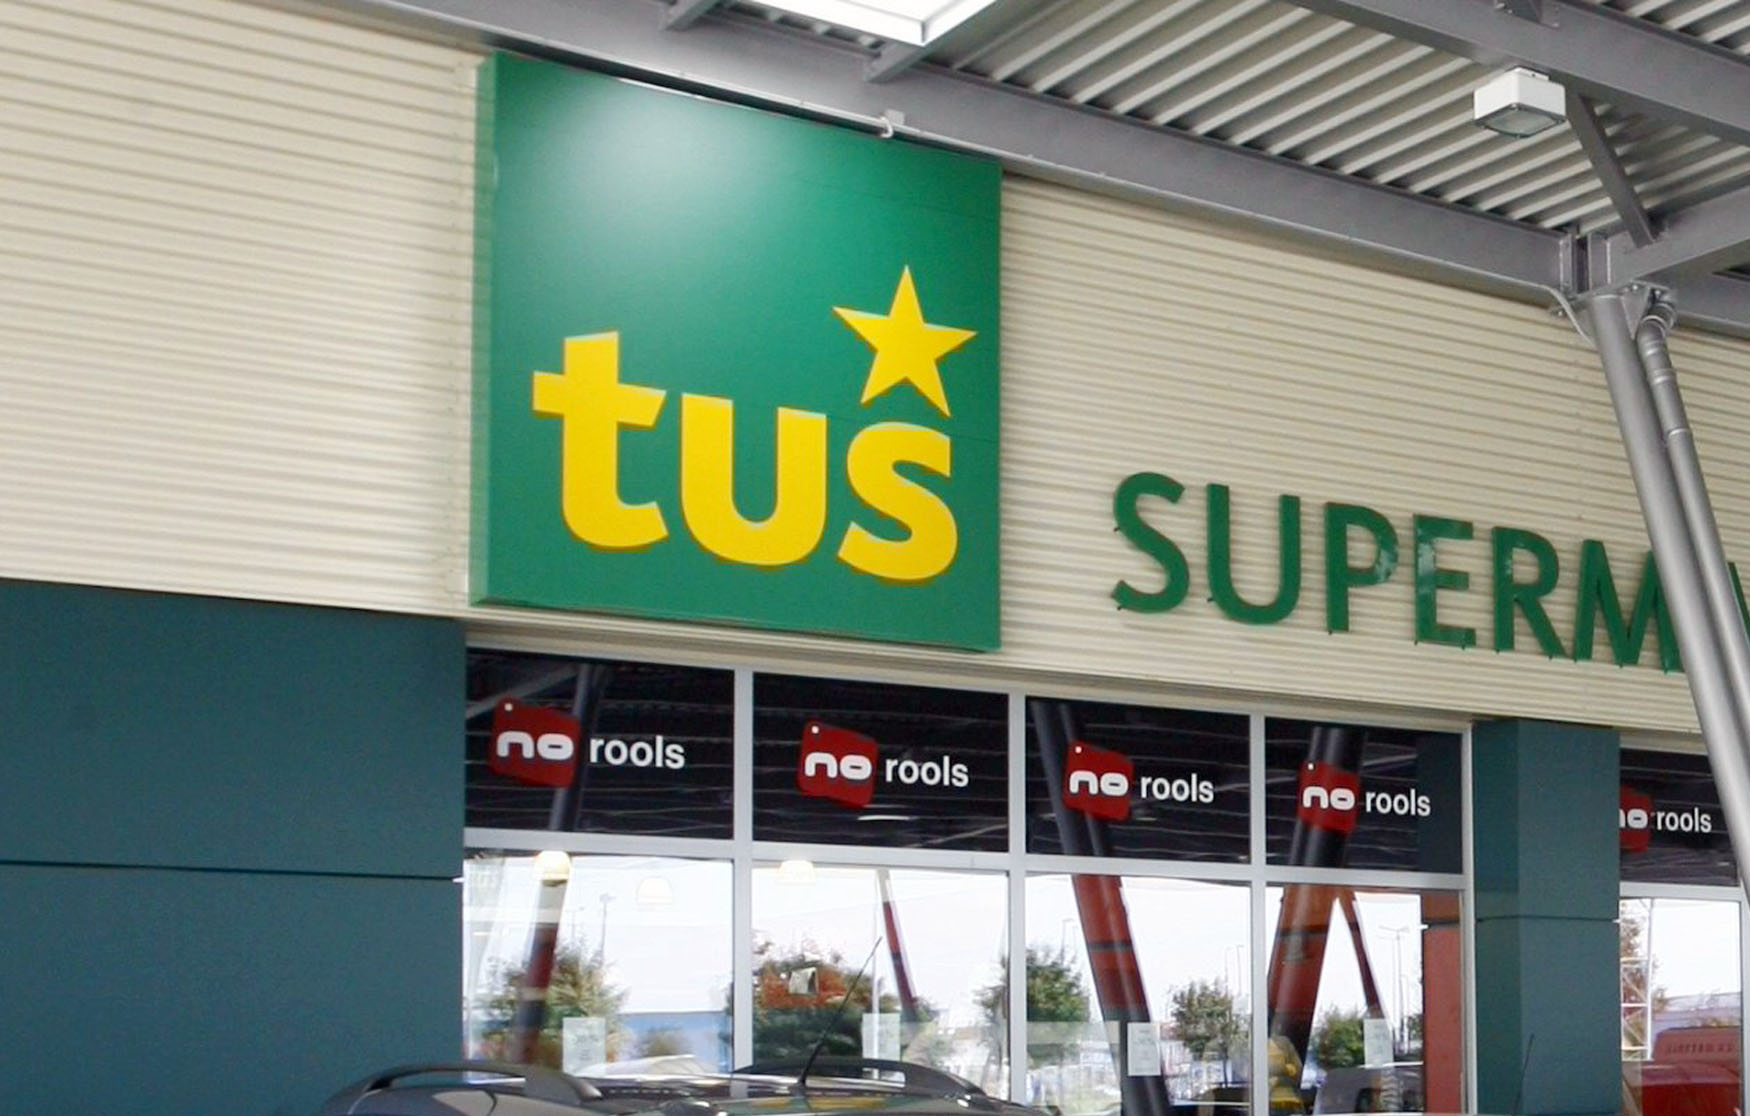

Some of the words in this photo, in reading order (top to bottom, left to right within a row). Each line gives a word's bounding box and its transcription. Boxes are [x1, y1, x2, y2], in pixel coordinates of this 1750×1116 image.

[589, 735, 686, 769] rools
[886, 756, 969, 788] rools
[1140, 774, 1215, 804] rools
[1364, 789, 1431, 818] rools
[1656, 806, 1712, 834] rools
